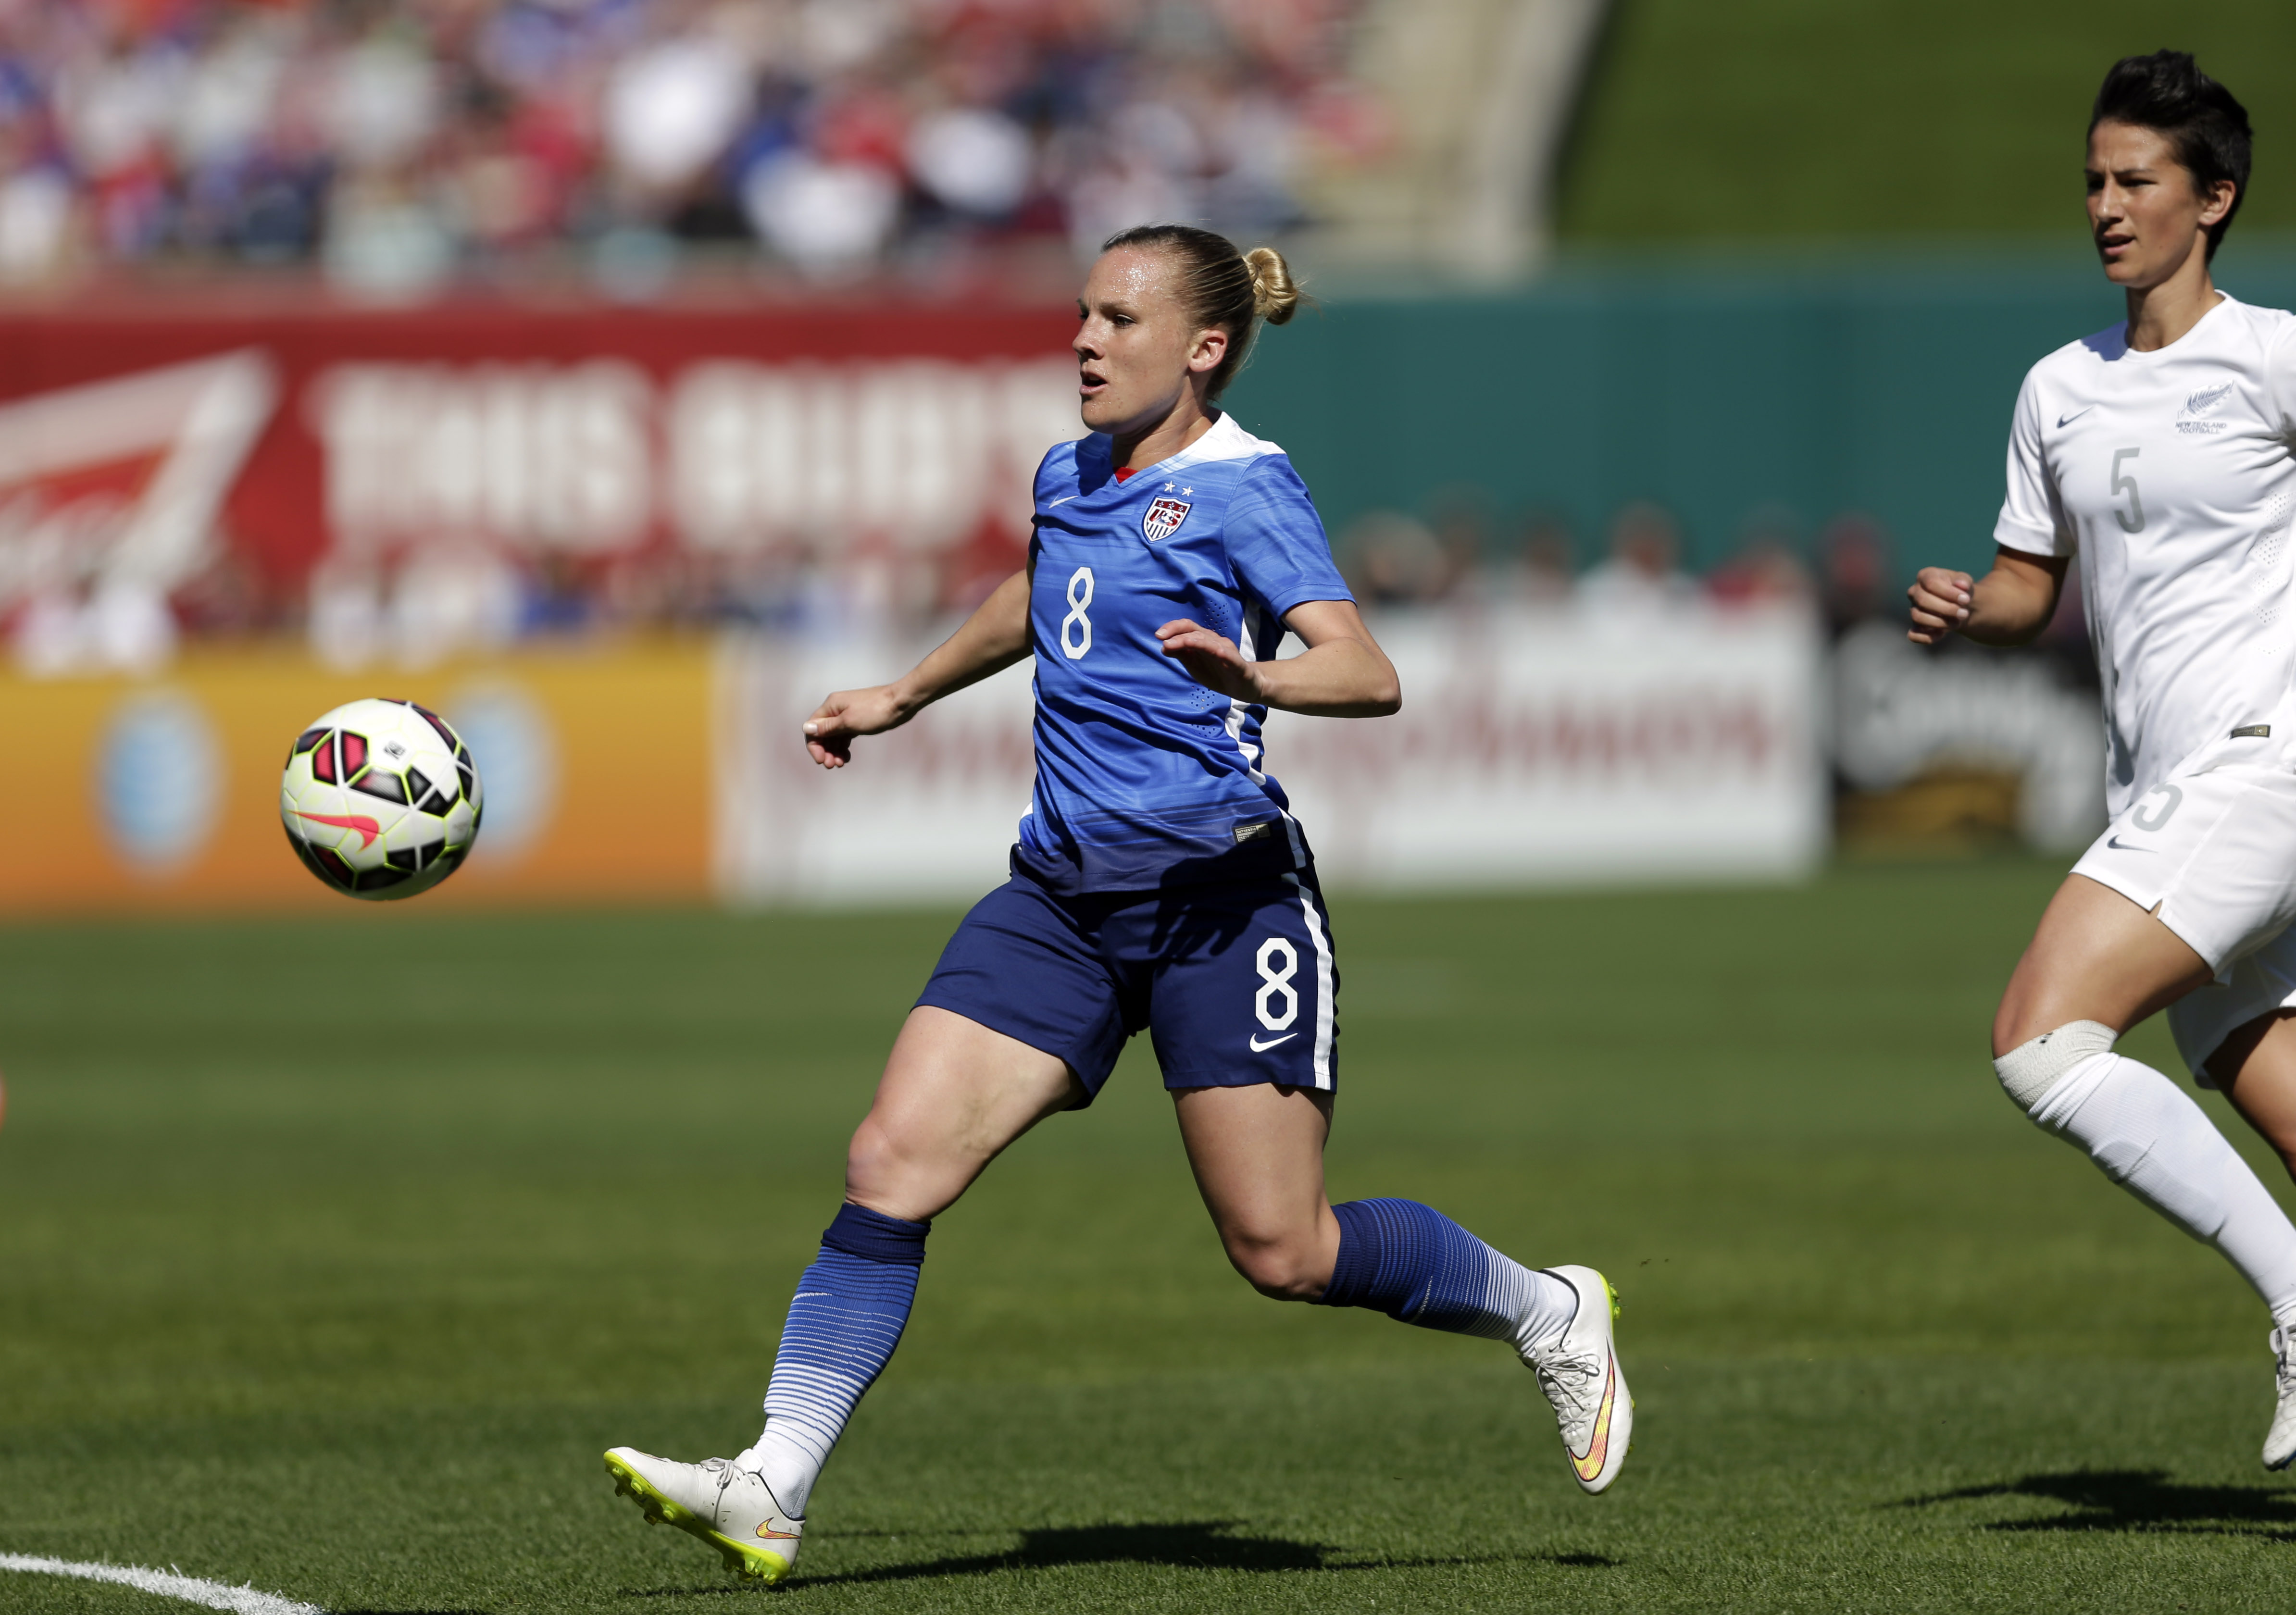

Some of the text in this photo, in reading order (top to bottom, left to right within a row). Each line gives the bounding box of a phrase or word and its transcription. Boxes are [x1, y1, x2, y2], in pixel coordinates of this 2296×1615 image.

[2110, 446, 2146, 534] 5
[1060, 566, 1095, 660] 8
[1255, 937, 1298, 1031] 8
